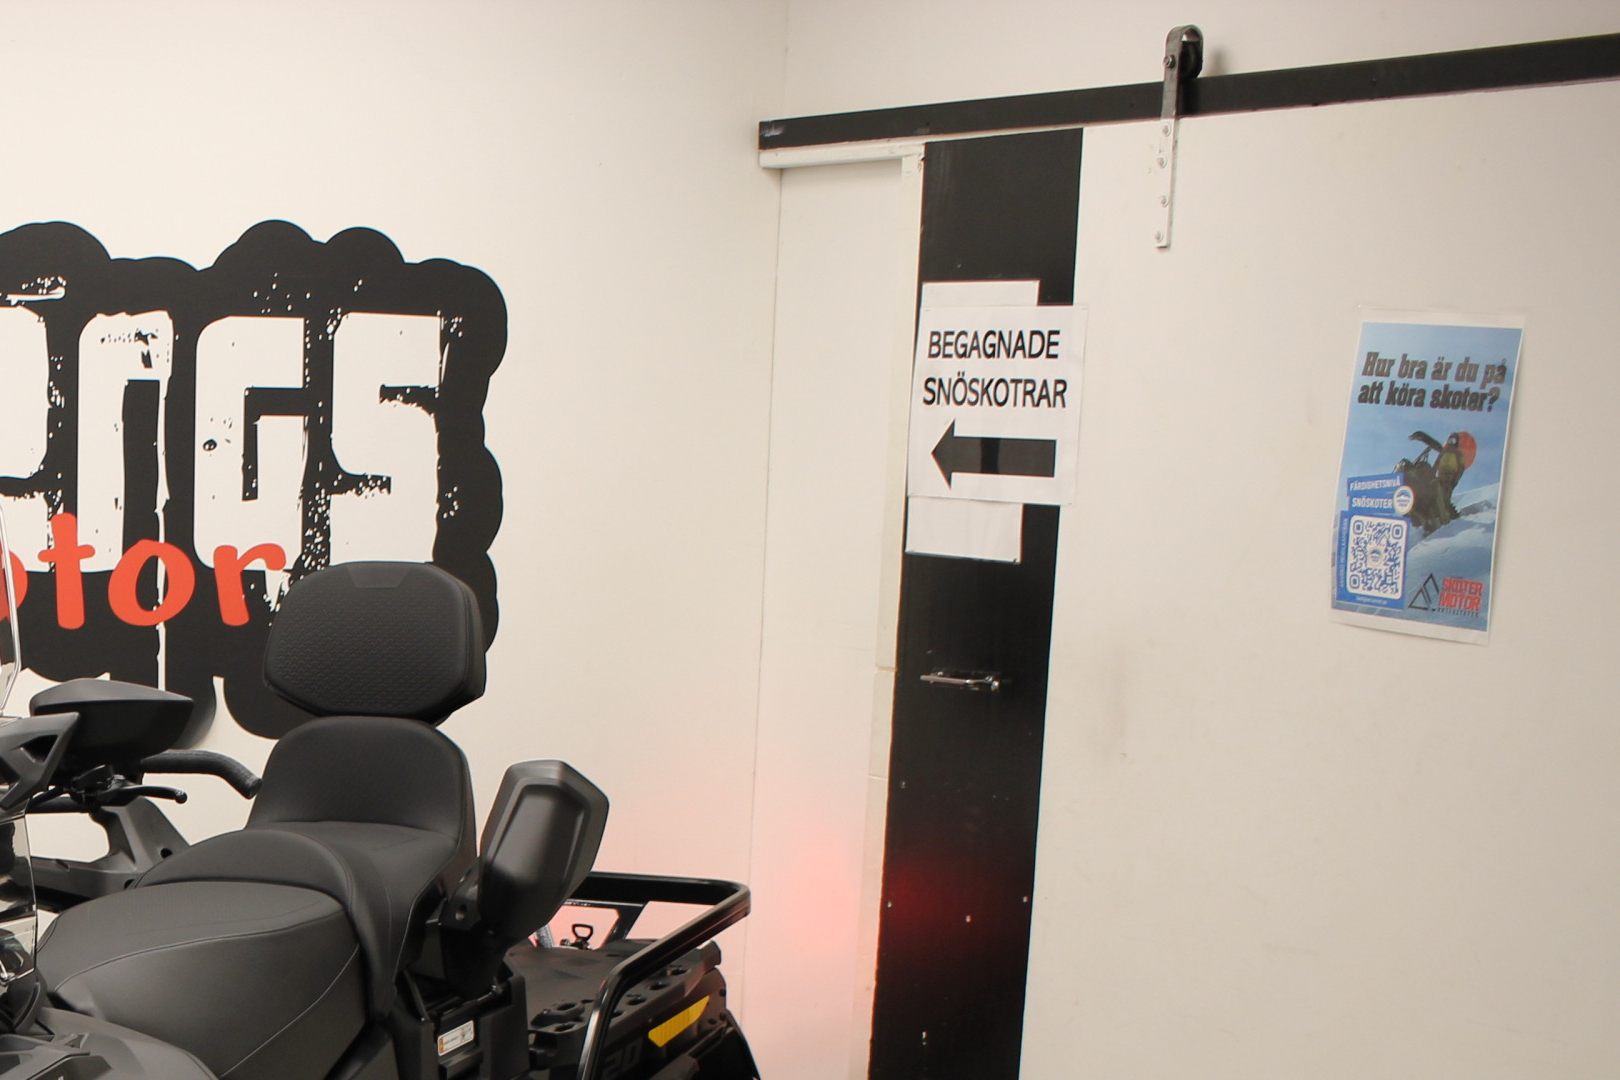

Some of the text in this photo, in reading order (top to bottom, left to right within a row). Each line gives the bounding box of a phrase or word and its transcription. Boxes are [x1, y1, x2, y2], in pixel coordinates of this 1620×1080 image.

[927, 329, 1061, 360] BEGAGNADE
[1361, 351, 1507, 390] Hur bra är du på
[922, 371, 1068, 409] SNÖSKOTRAR
[1357, 380, 1501, 413] att köra skoter?
[1349, 475, 1401, 491] FÄRDIGHETSNIVÅ
[1352, 495, 1393, 509] SNÖSKOTER
[1442, 577, 1484, 596] SKOTER
[1438, 592, 1482, 611] MOTOR
